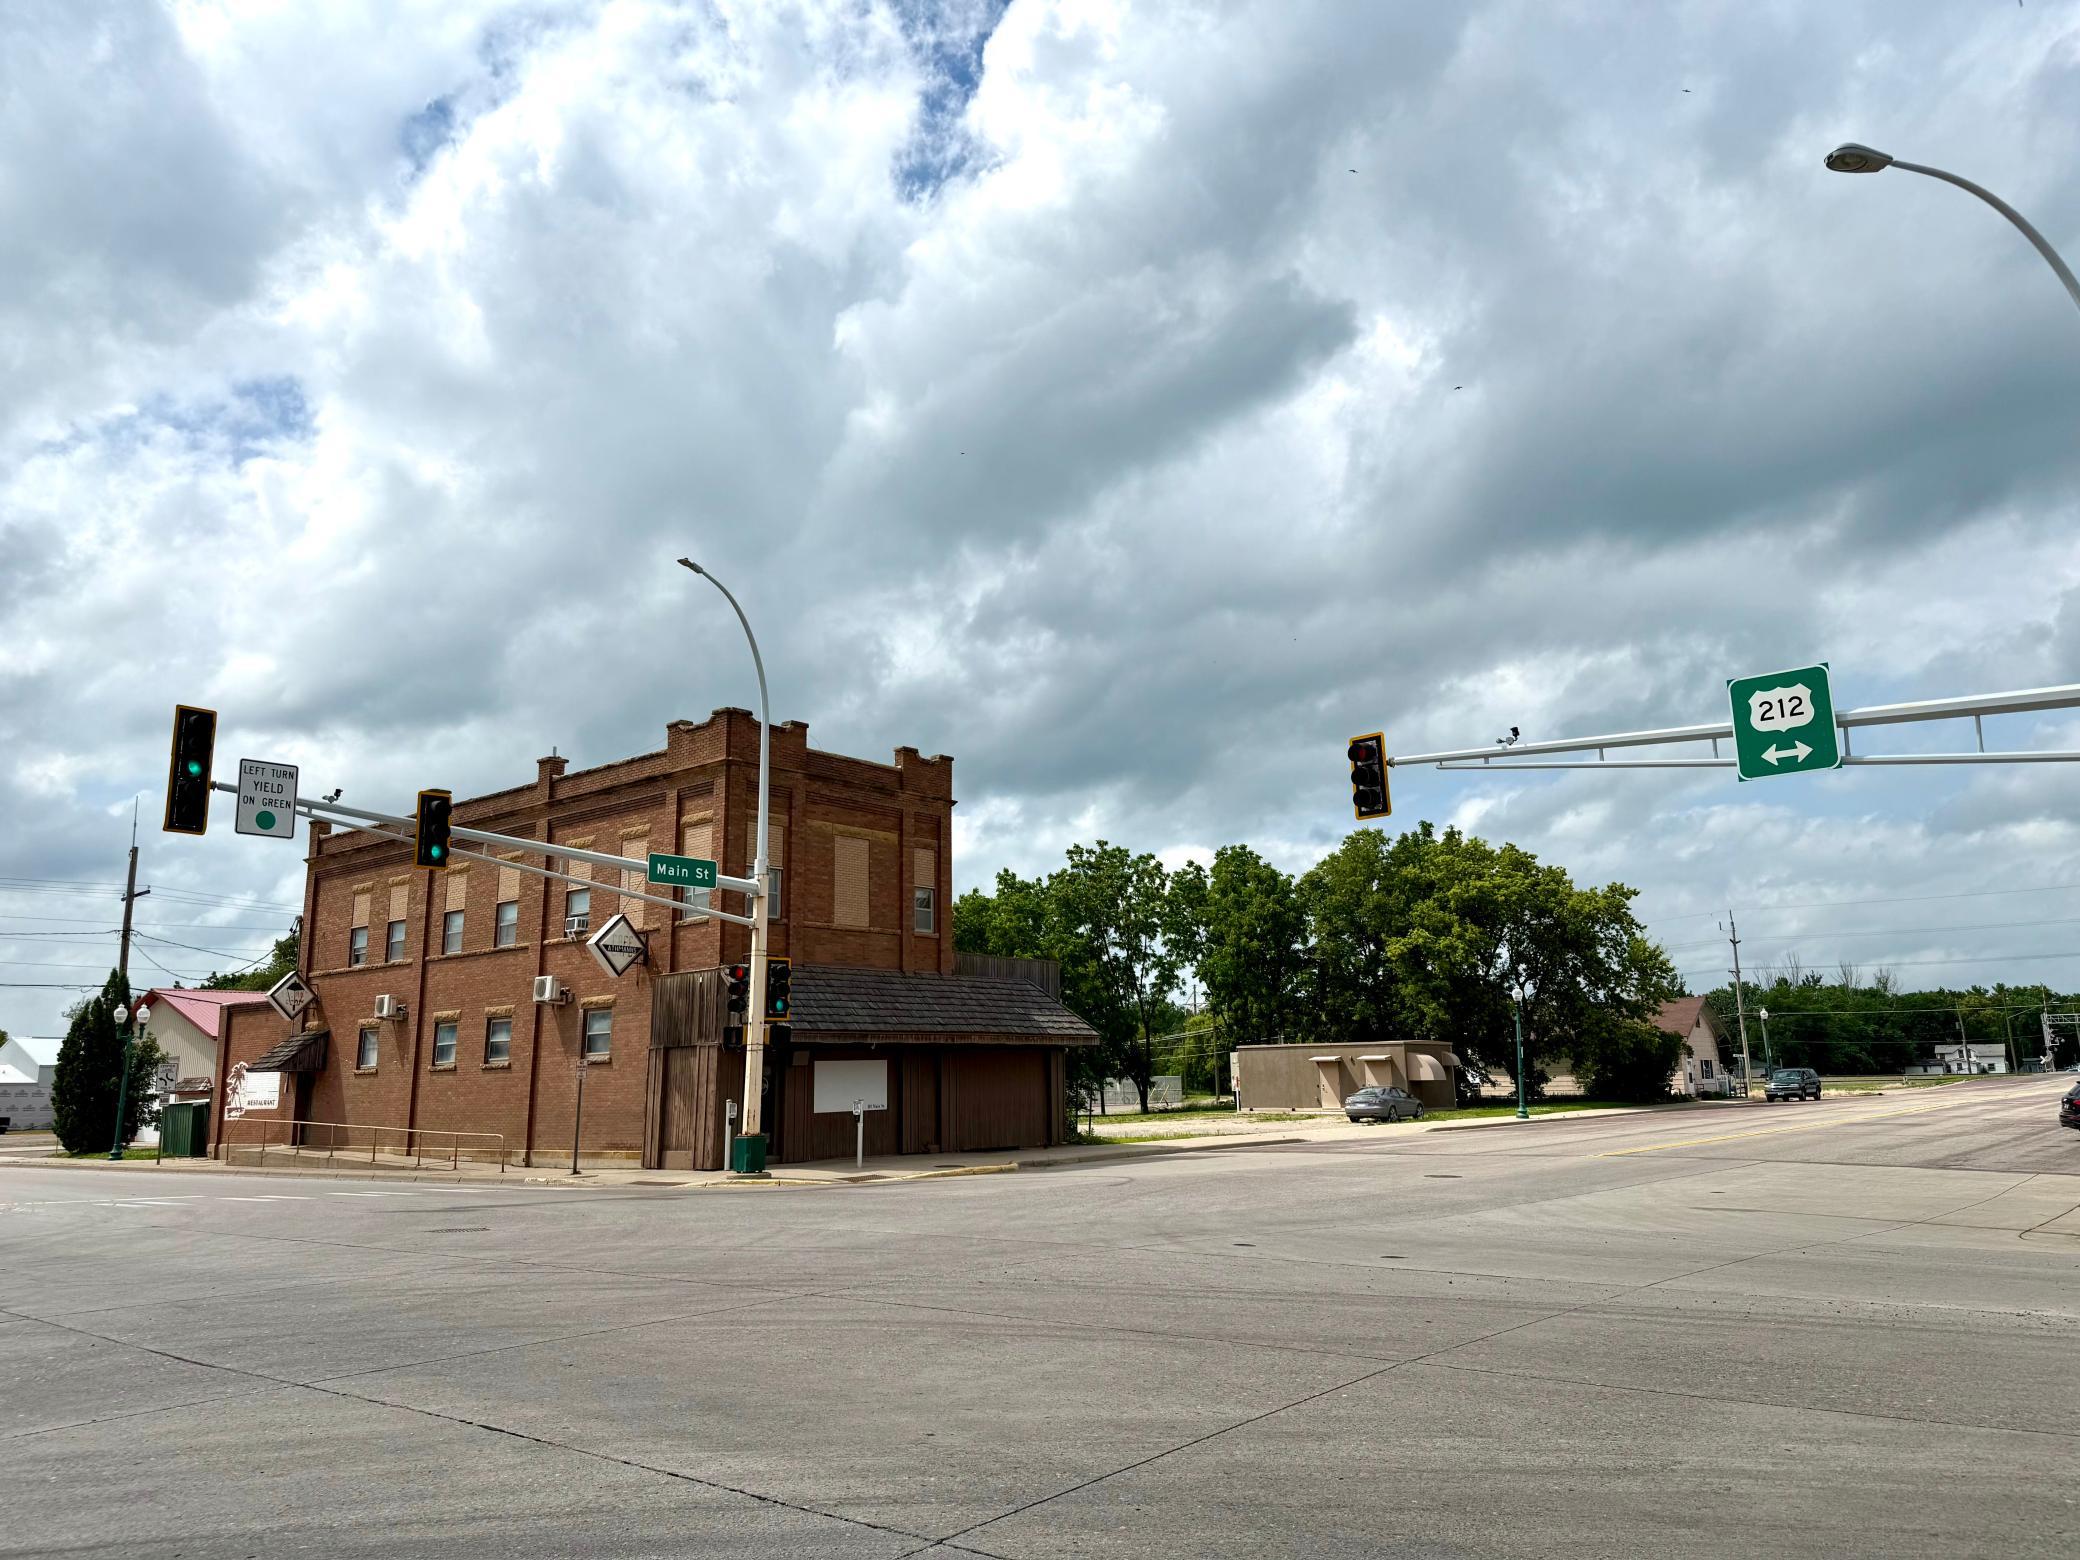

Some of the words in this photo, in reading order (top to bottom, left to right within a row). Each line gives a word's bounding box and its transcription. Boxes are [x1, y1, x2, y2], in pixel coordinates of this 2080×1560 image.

[1759, 696, 1804, 721] 212
[244, 765, 266, 777] LEFT
[272, 769, 295, 780] TURN
[254, 780, 284, 794] YIELD
[243, 795, 255, 805] ON
[262, 798, 291, 809] GREEN
[657, 863, 688, 878] Main
[696, 867, 709, 880] St
